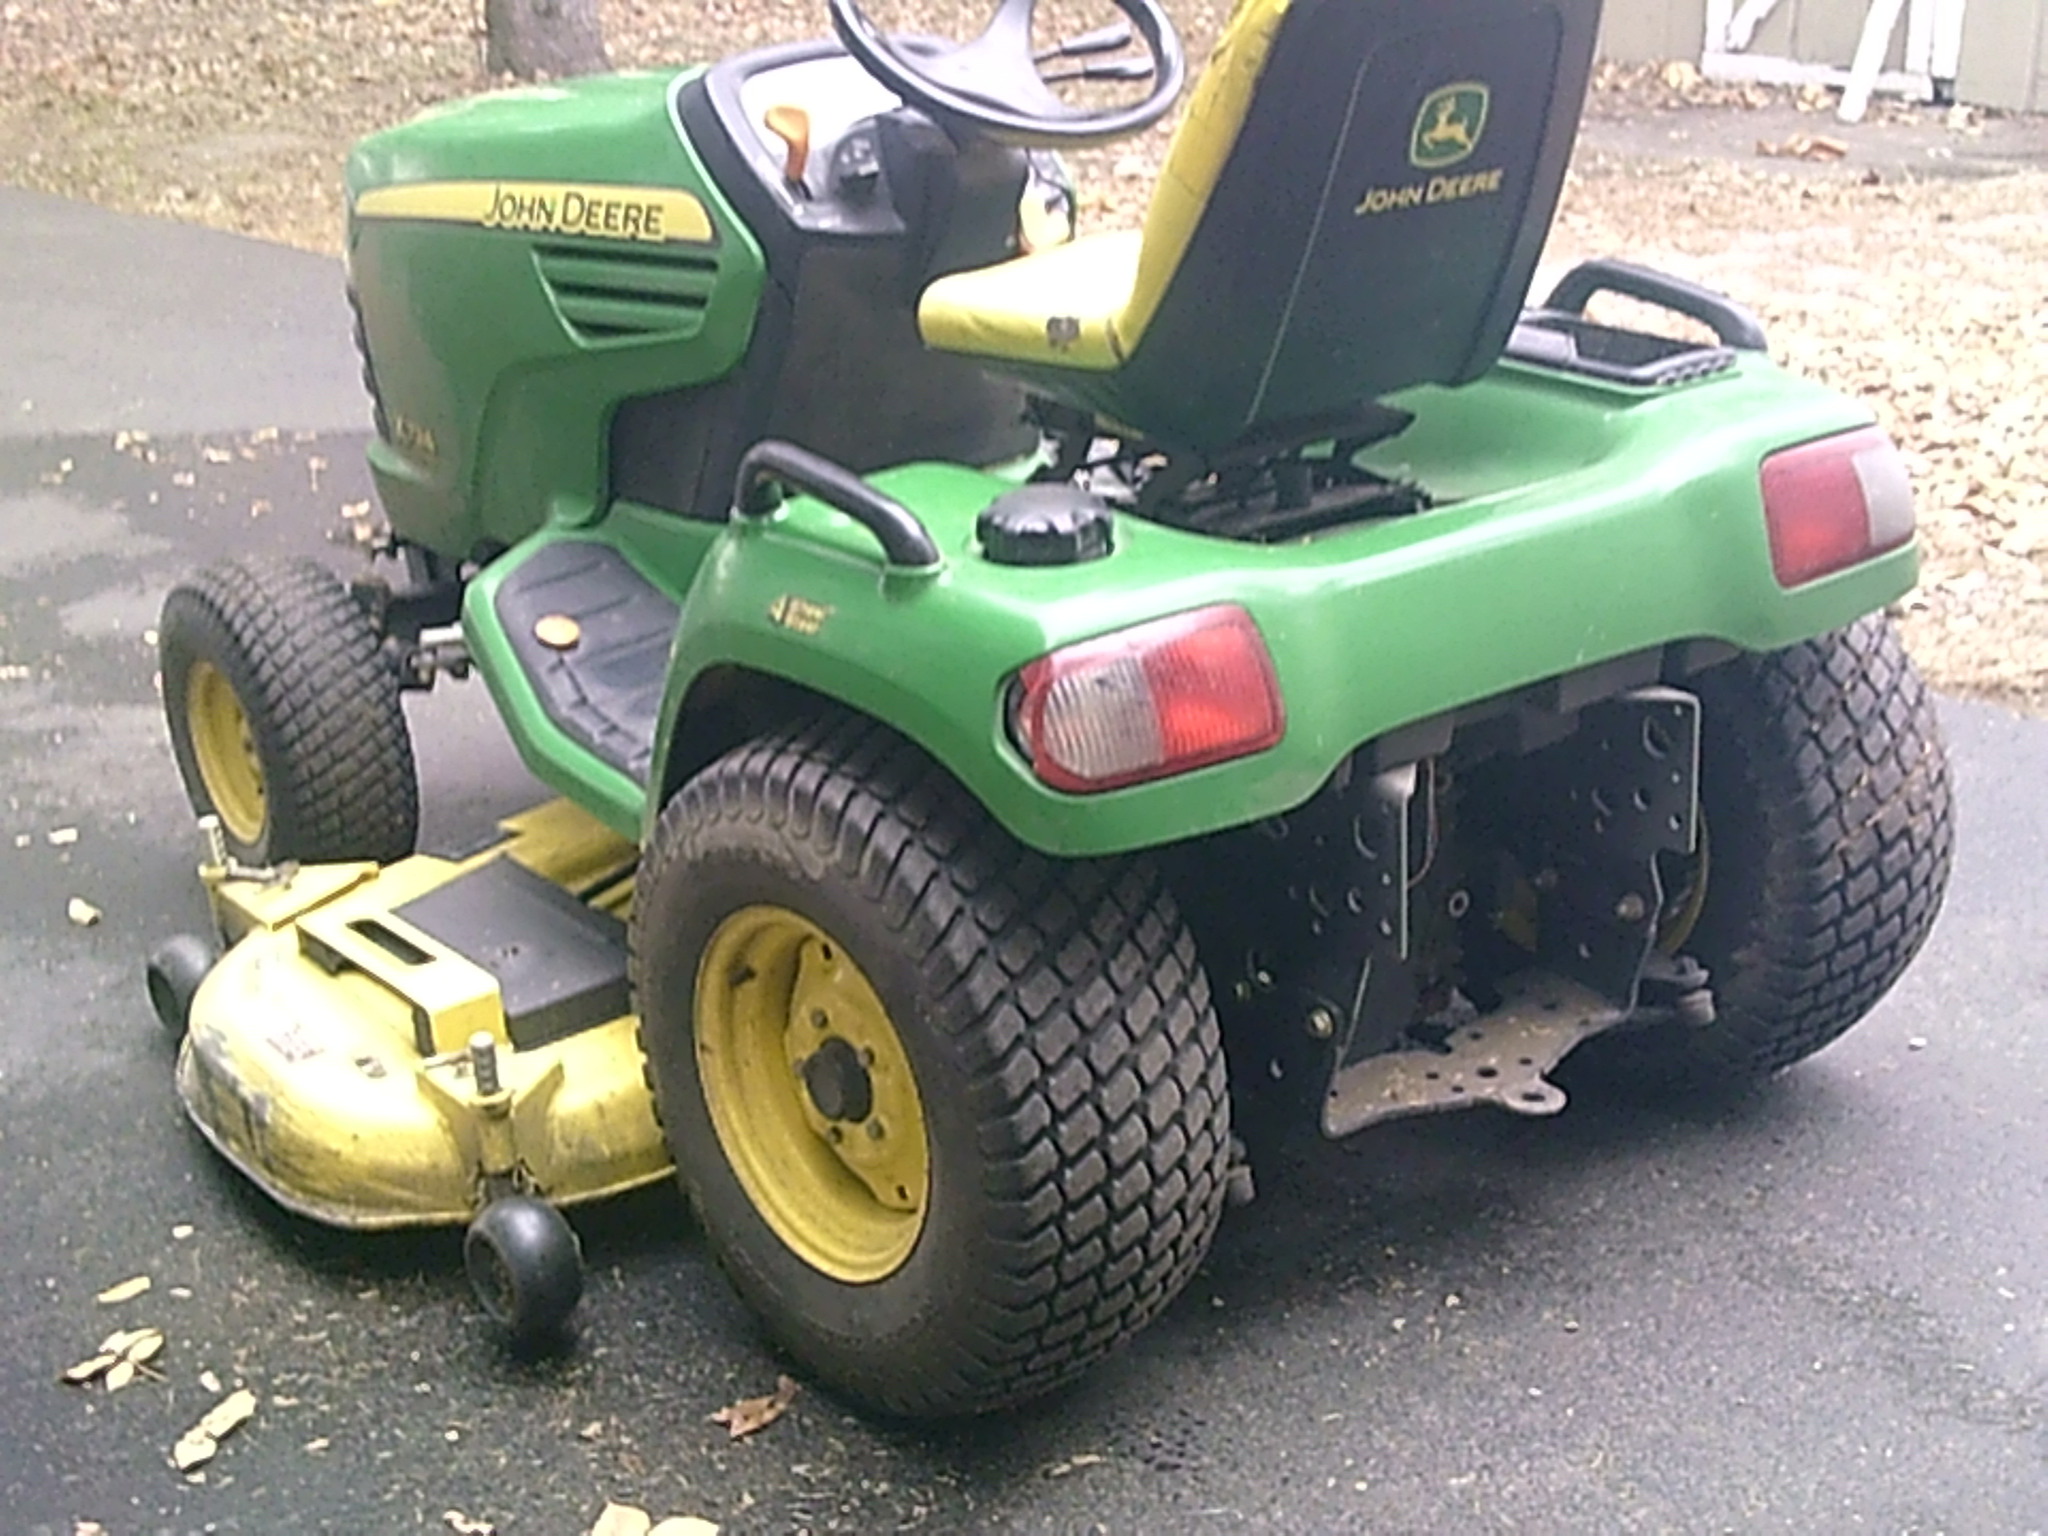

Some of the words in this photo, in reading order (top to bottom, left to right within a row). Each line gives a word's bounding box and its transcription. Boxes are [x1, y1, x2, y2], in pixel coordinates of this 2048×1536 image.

[484, 182, 556, 224] JOHN
[561, 190, 664, 236] DEERE
[1354, 184, 1424, 215] JOHN
[1426, 168, 1503, 204] DEERE
